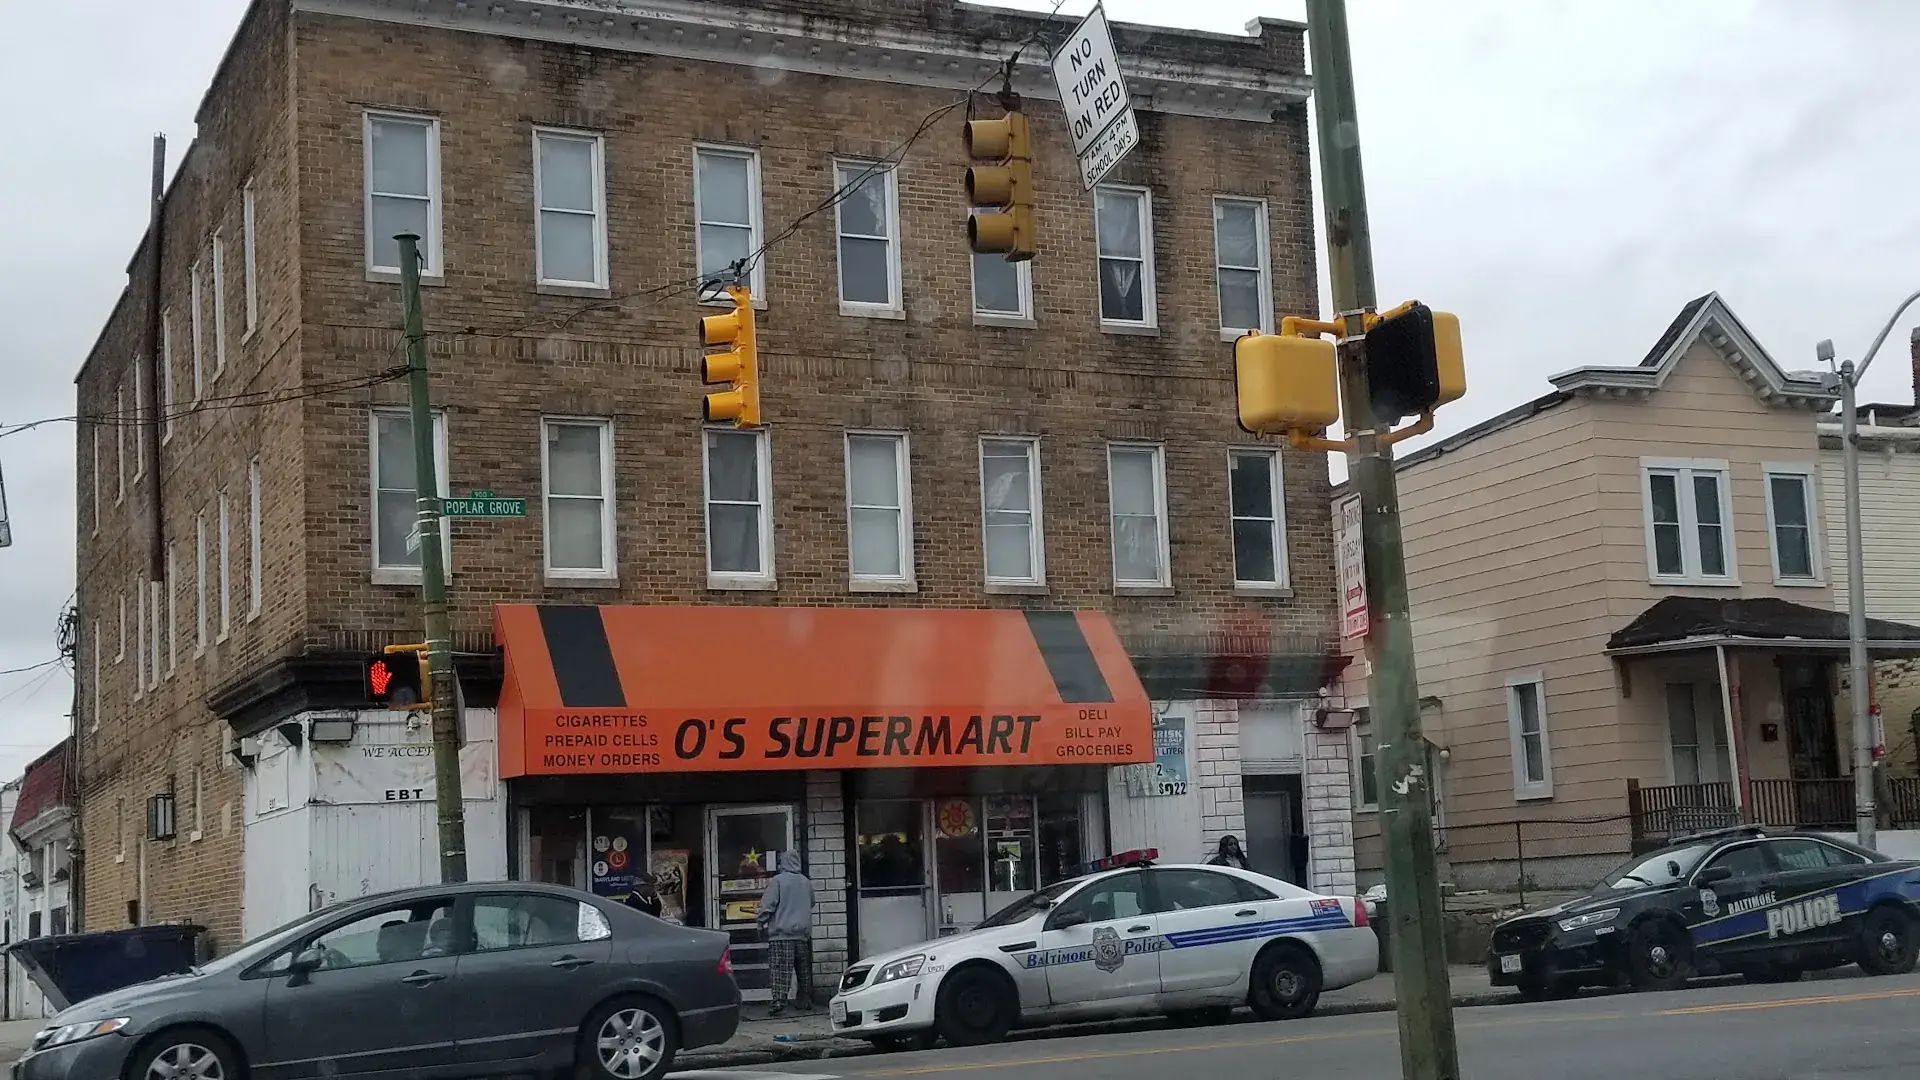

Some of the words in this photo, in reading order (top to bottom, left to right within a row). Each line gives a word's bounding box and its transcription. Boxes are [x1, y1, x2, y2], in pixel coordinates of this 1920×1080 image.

[1070, 37, 1092, 73] NO
[1072, 57, 1106, 106] TURN
[1074, 109, 1093, 140] ON
[1094, 80, 1120, 120] RED
[1086, 151, 1114, 184] SCHOOL
[1113, 130, 1132, 156] DAYS
[445, 501, 485, 515] POPLAR
[489, 501, 522, 514] GROVE
[555, 715, 648, 728] CIGARETTES
[1078, 709, 1108, 721] DELI
[674, 717, 747, 760] O'S
[764, 715, 1042, 759] SUPERMART
[1065, 727, 1094, 739] BILL
[1098, 726, 1122, 738] PAY
[545, 735, 608, 747] PREPAID
[612, 734, 659, 747] CELLS
[362, 747, 385, 758] WE
[387, 746, 435, 757] ACCEP
[1056, 744, 1133, 757] GROCERIES
[543, 754, 596, 767] MONEY
[600, 753, 661, 766] ORDERS
[1156, 763, 1163, 777] 2
[385, 788, 424, 801] EBT
[1727, 891, 1778, 915] BALTIMORE
[1766, 893, 1843, 939] POLICE
